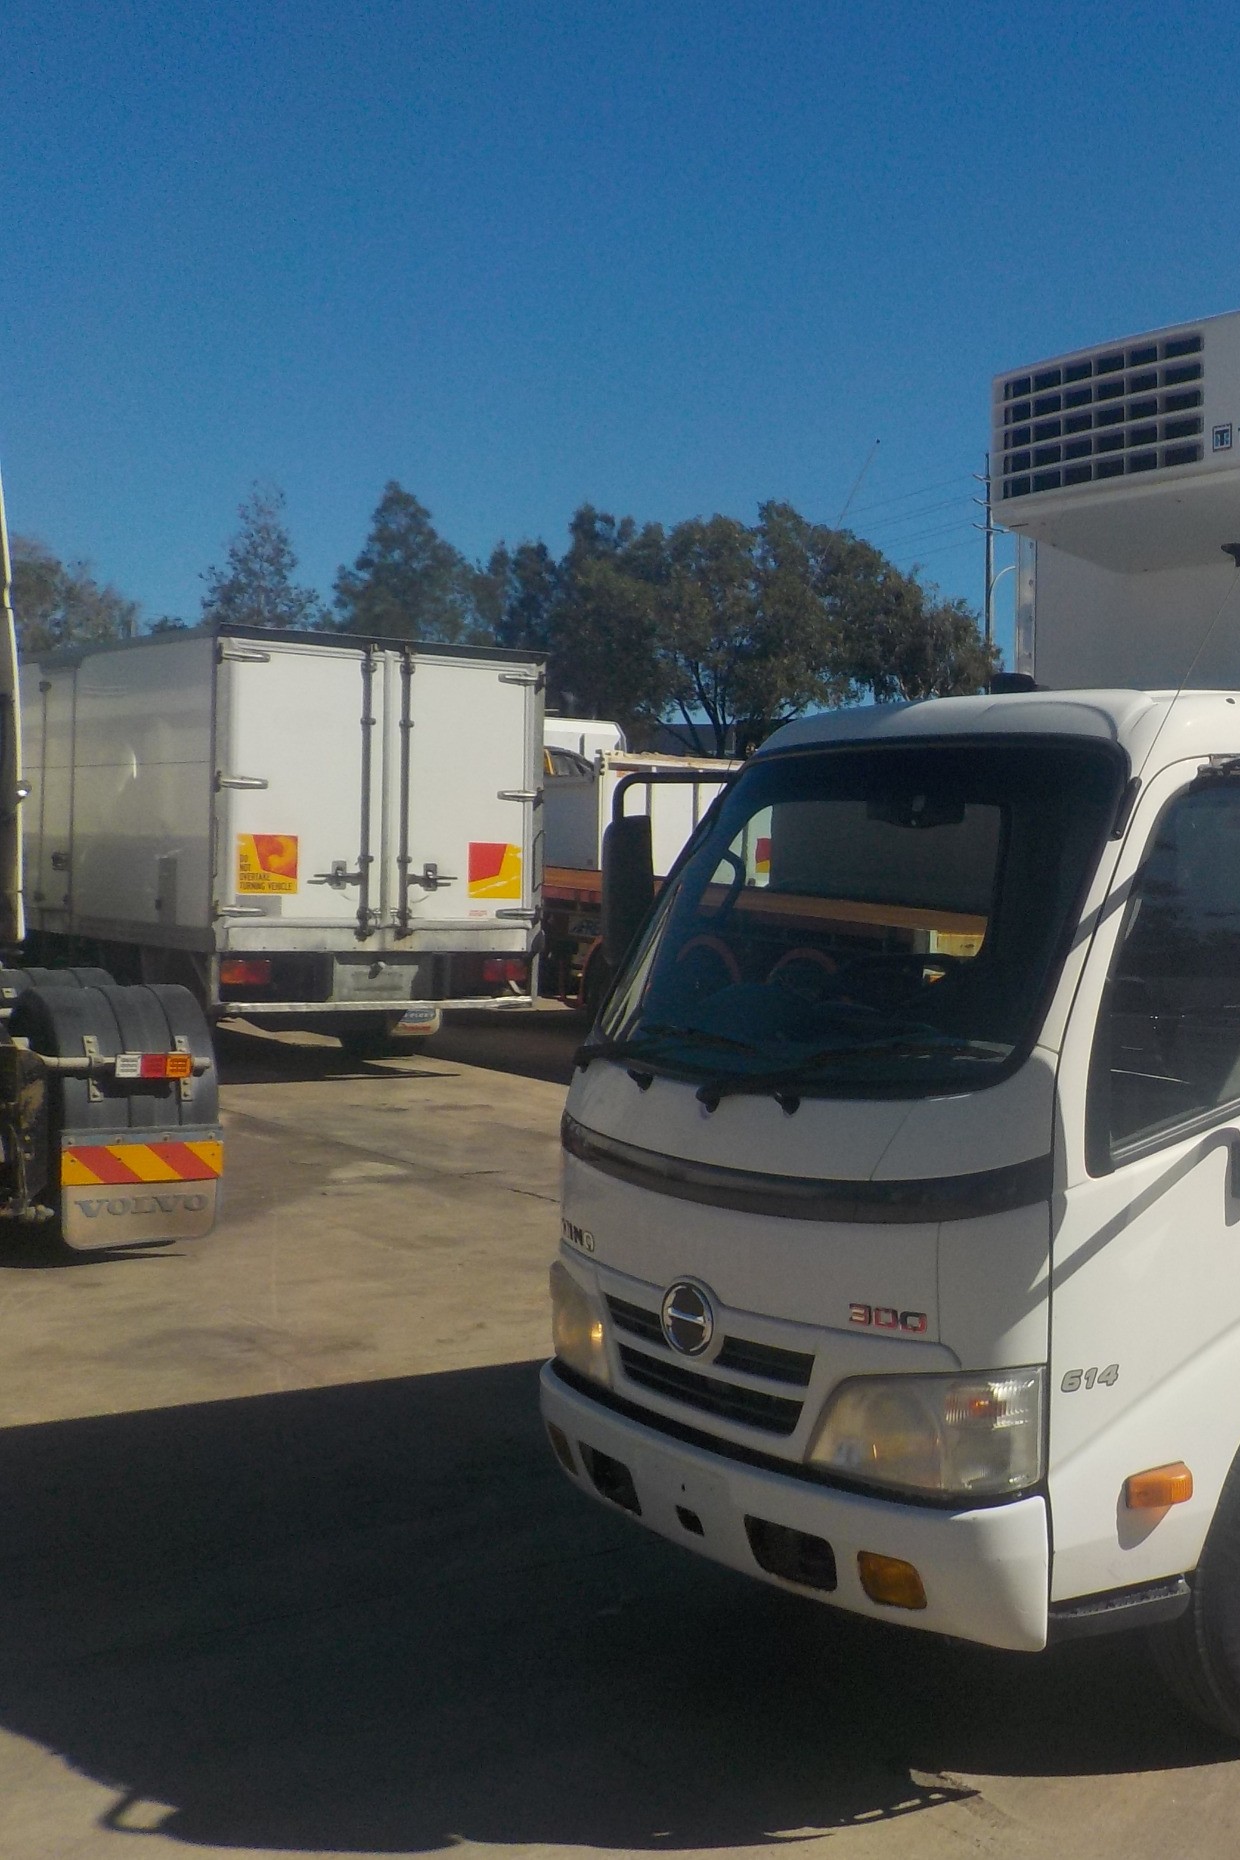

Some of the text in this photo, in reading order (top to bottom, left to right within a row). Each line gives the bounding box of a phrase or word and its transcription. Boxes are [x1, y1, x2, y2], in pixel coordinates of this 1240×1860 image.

[74, 1193, 210, 1219] VOLVO
[848, 1302, 928, 1334] 300
[1060, 1363, 1120, 1394] 614
